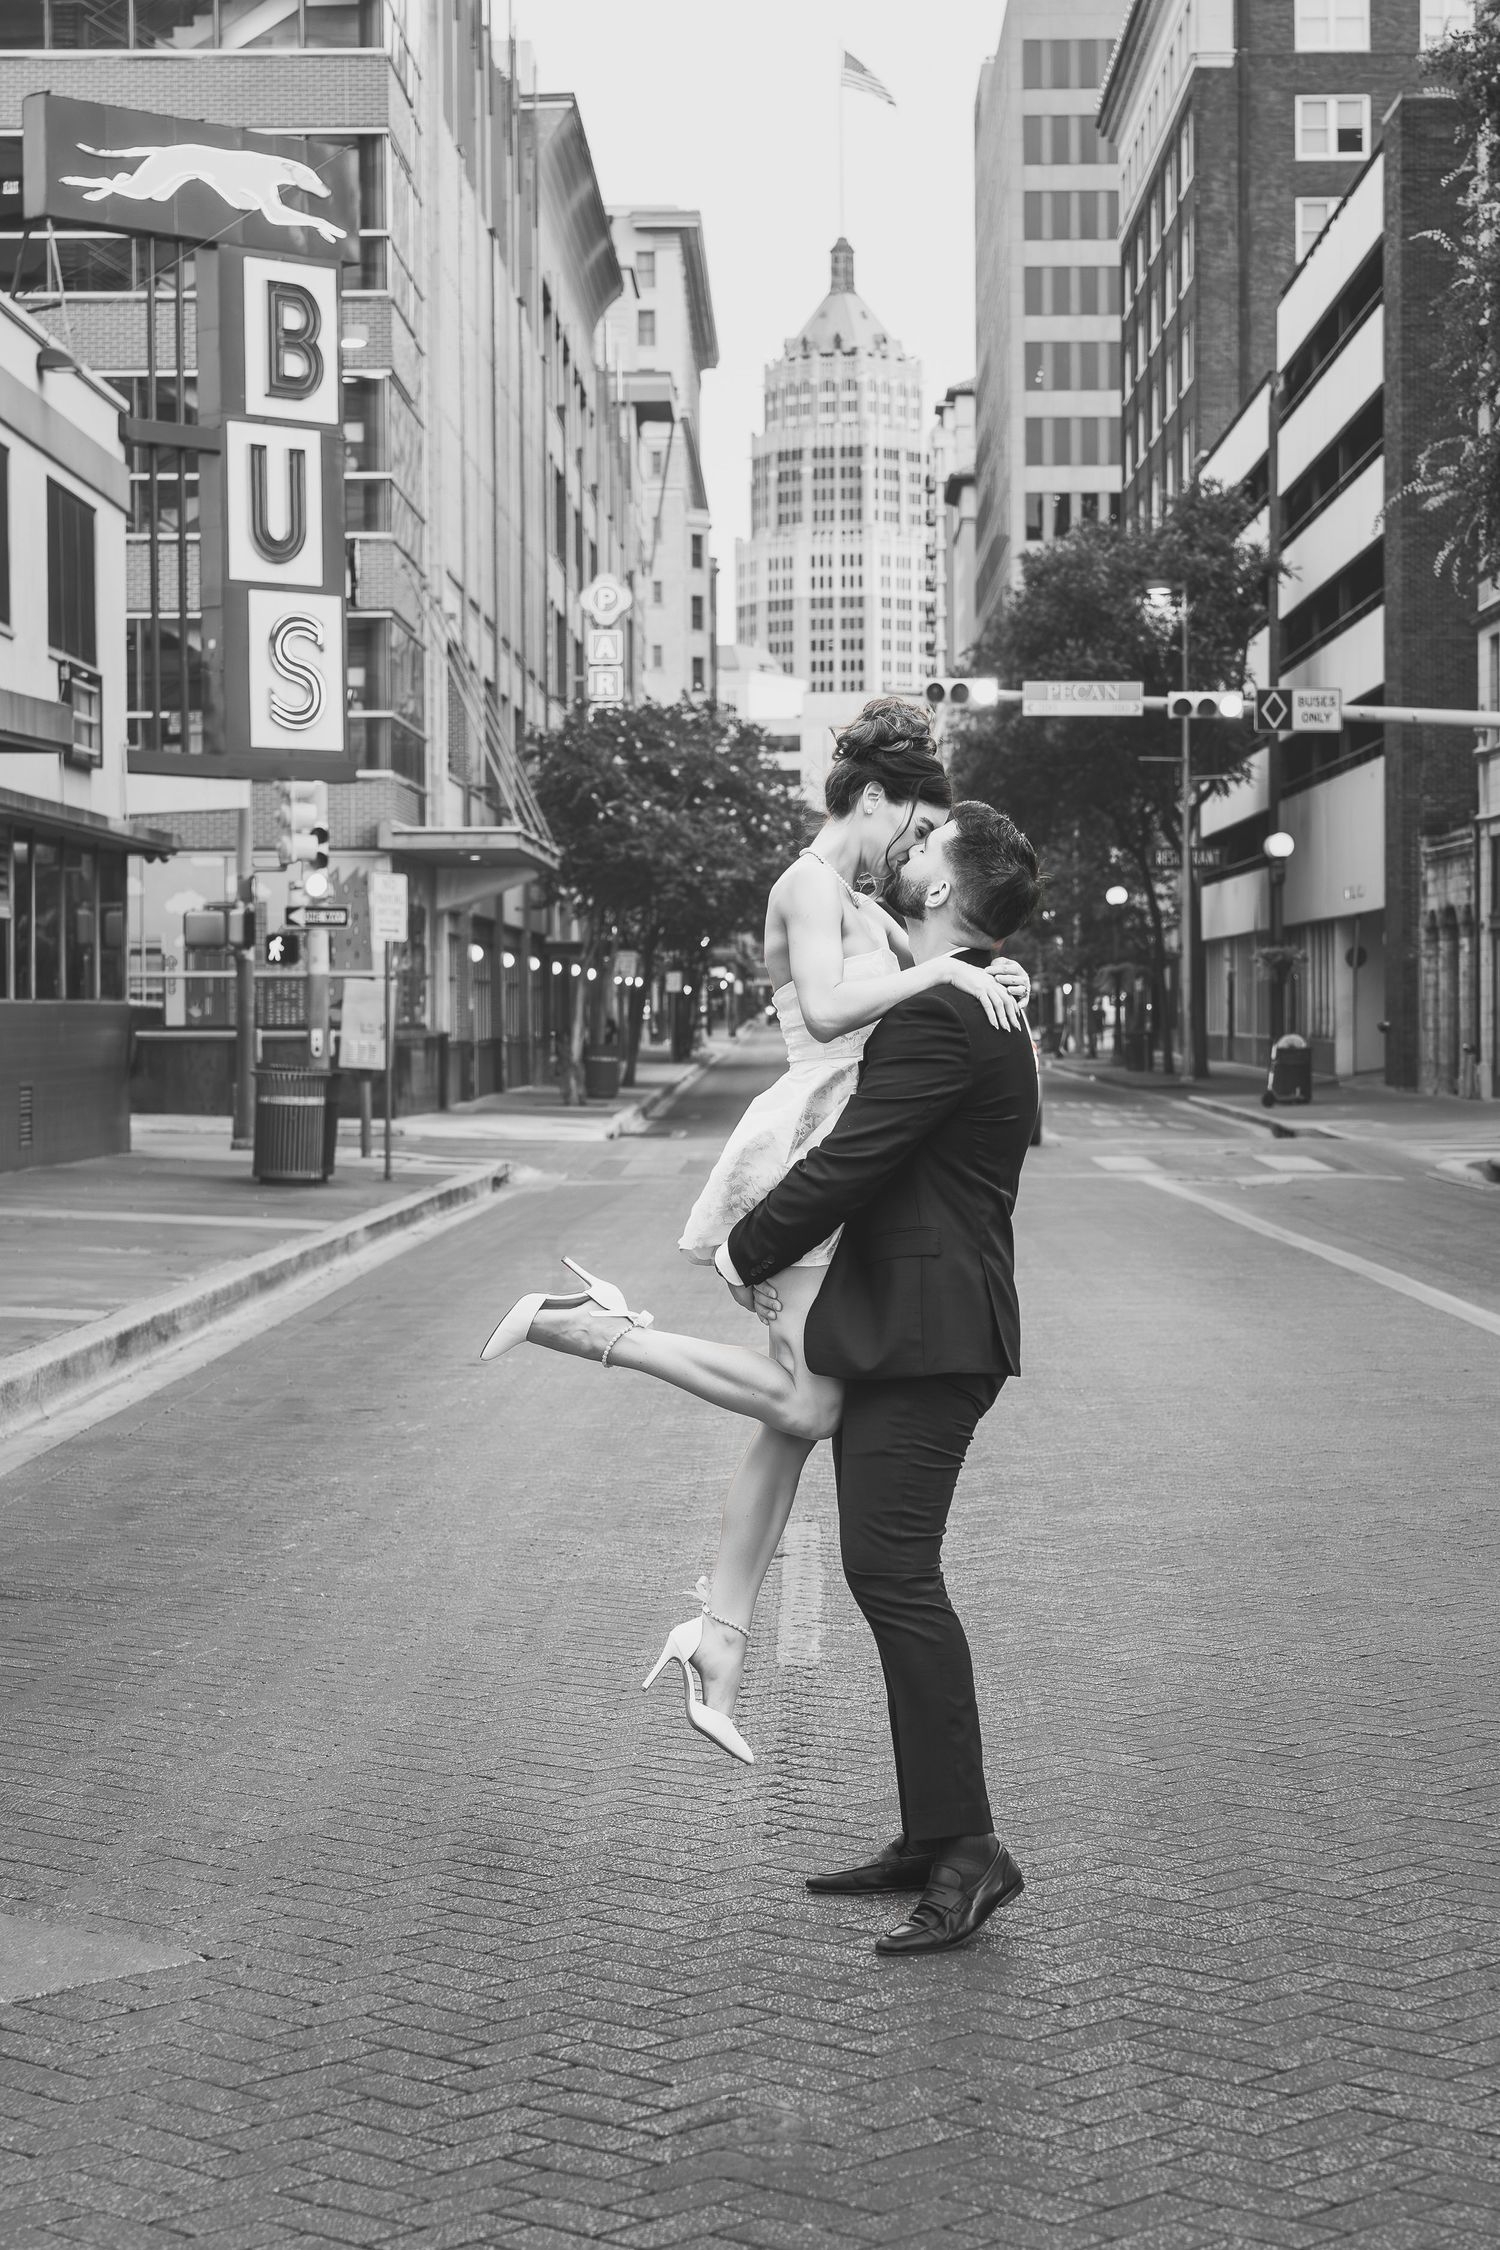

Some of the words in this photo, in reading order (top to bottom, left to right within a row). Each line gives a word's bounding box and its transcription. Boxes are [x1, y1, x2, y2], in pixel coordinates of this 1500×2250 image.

[249, 279, 327, 731] BUS
[595, 587, 617, 695] PAR
[1046, 685, 1120, 701] PECAN
[1297, 696, 1336, 707] BUSES
[1301, 712, 1332, 723] ONLY
[1155, 849, 1220, 865] RESRANT
